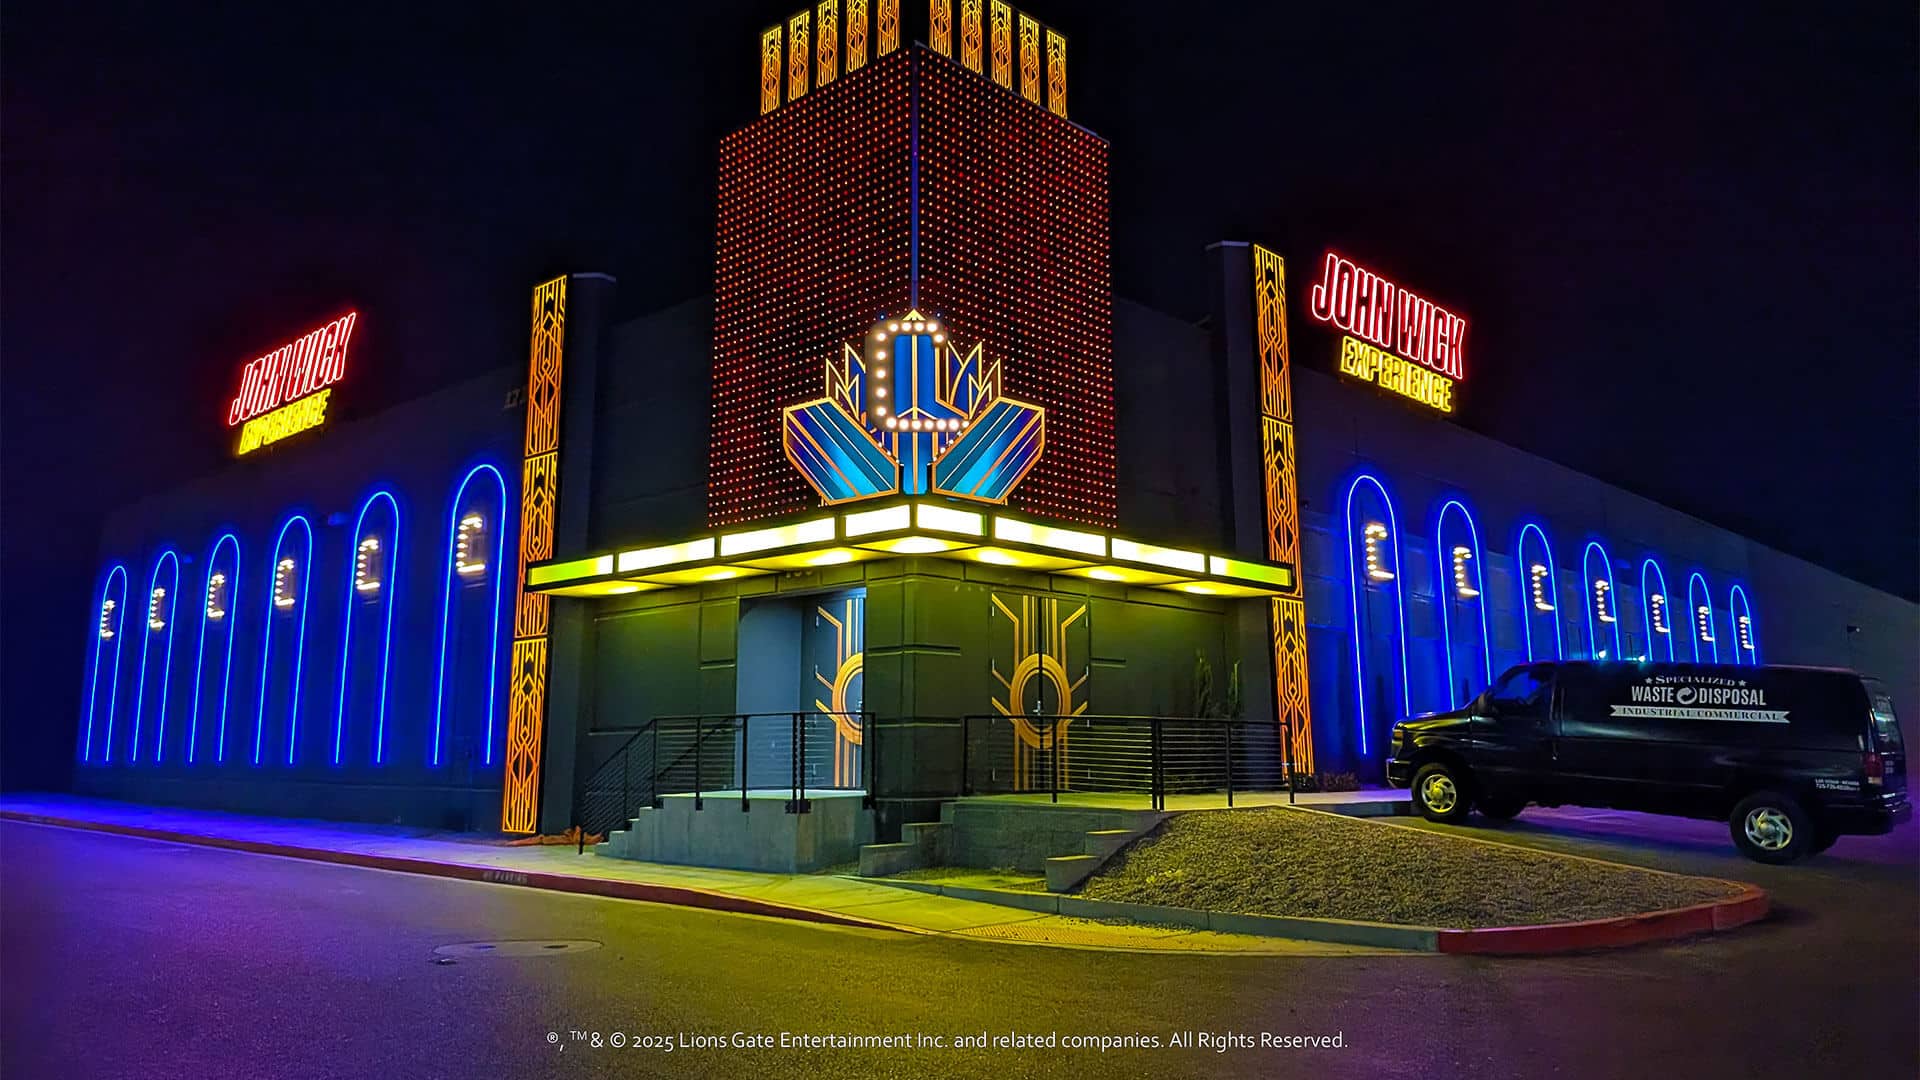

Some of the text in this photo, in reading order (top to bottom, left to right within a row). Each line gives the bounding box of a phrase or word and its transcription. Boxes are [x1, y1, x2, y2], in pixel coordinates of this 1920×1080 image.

[1311, 253, 1465, 380] JOHN WICK
[229, 311, 357, 426] JOHN WICK
[1340, 335, 1454, 413] EXPERIENCE
[238, 387, 332, 455] EXPERIENCE
[1622, 706, 1781, 722] INDUSTRIAL COMMERCIAL
[1631, 685, 1768, 706] WASTE DISPOSAL
